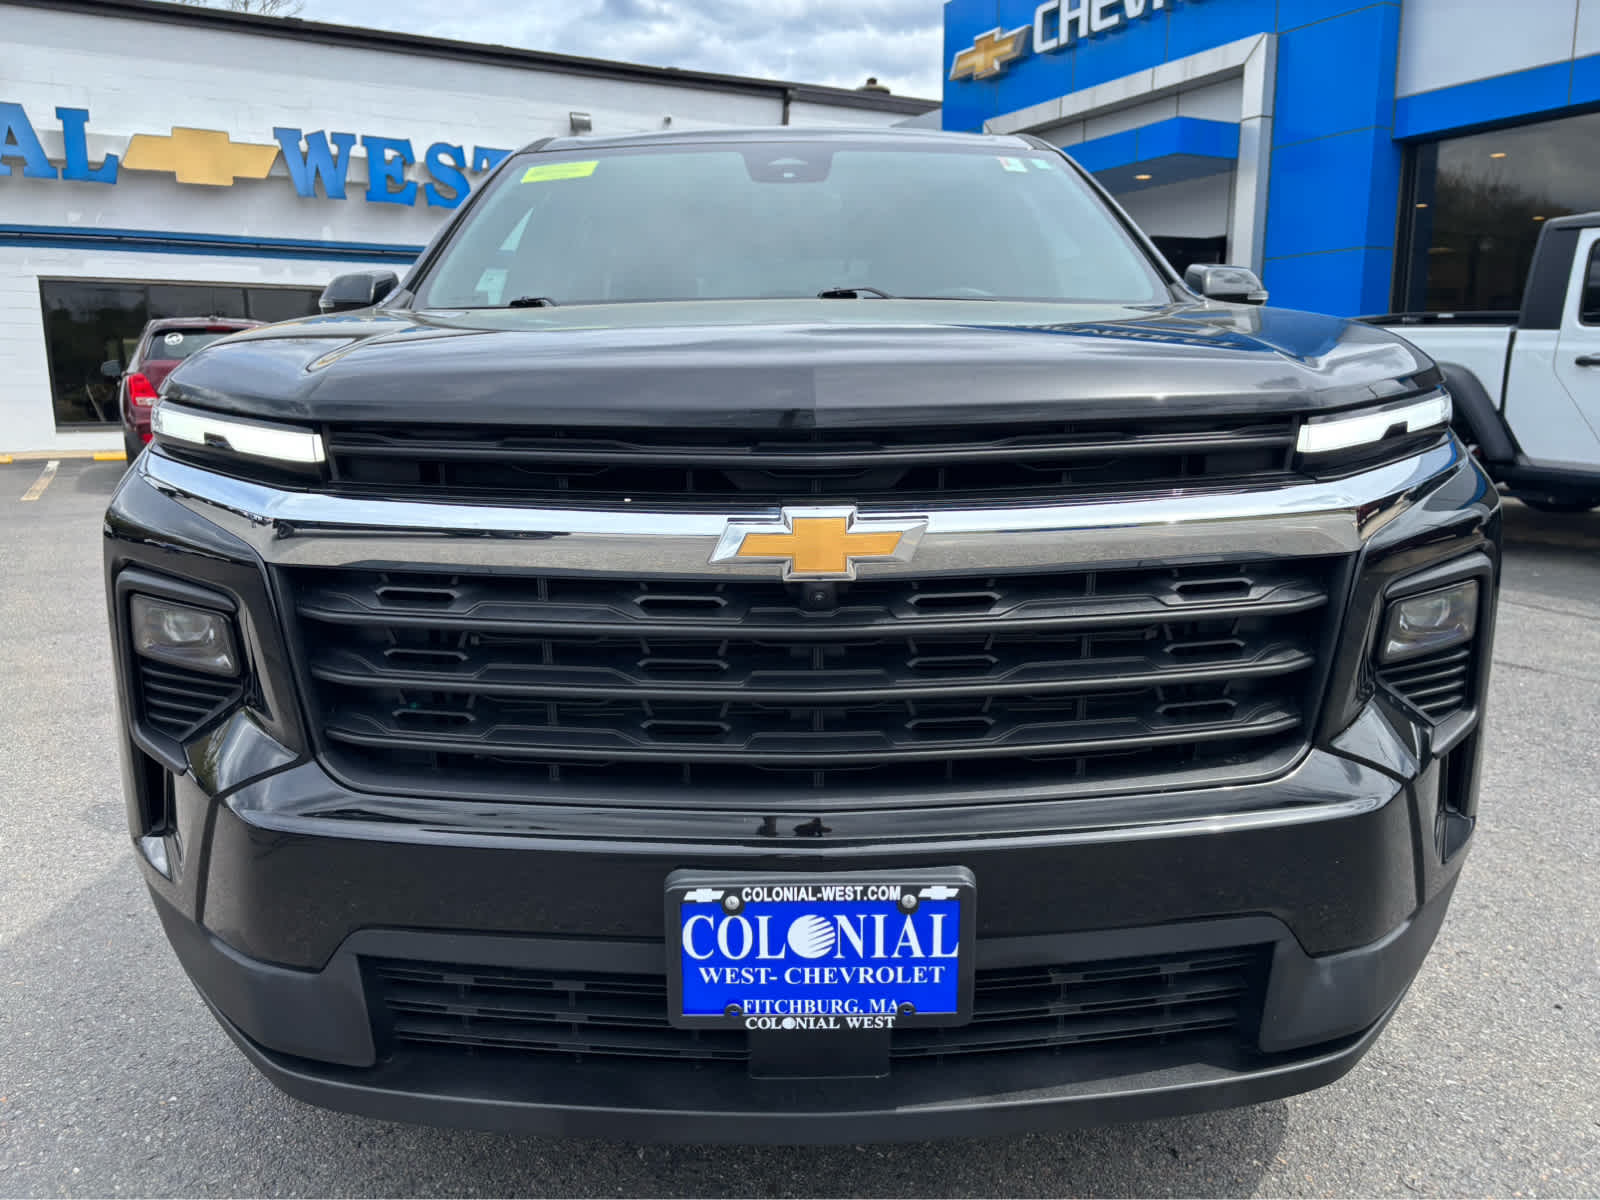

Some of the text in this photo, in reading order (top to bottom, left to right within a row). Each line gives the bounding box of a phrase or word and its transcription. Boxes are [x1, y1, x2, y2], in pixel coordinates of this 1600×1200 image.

[741, 886, 901, 902] COLONIAL-WEST.COM
[682, 914, 959, 960] COLONIAL
[784, 965, 946, 985] CHEVROLET
[868, 999, 899, 1014] MA
[745, 1015, 896, 1030] COLONIAL WEST
